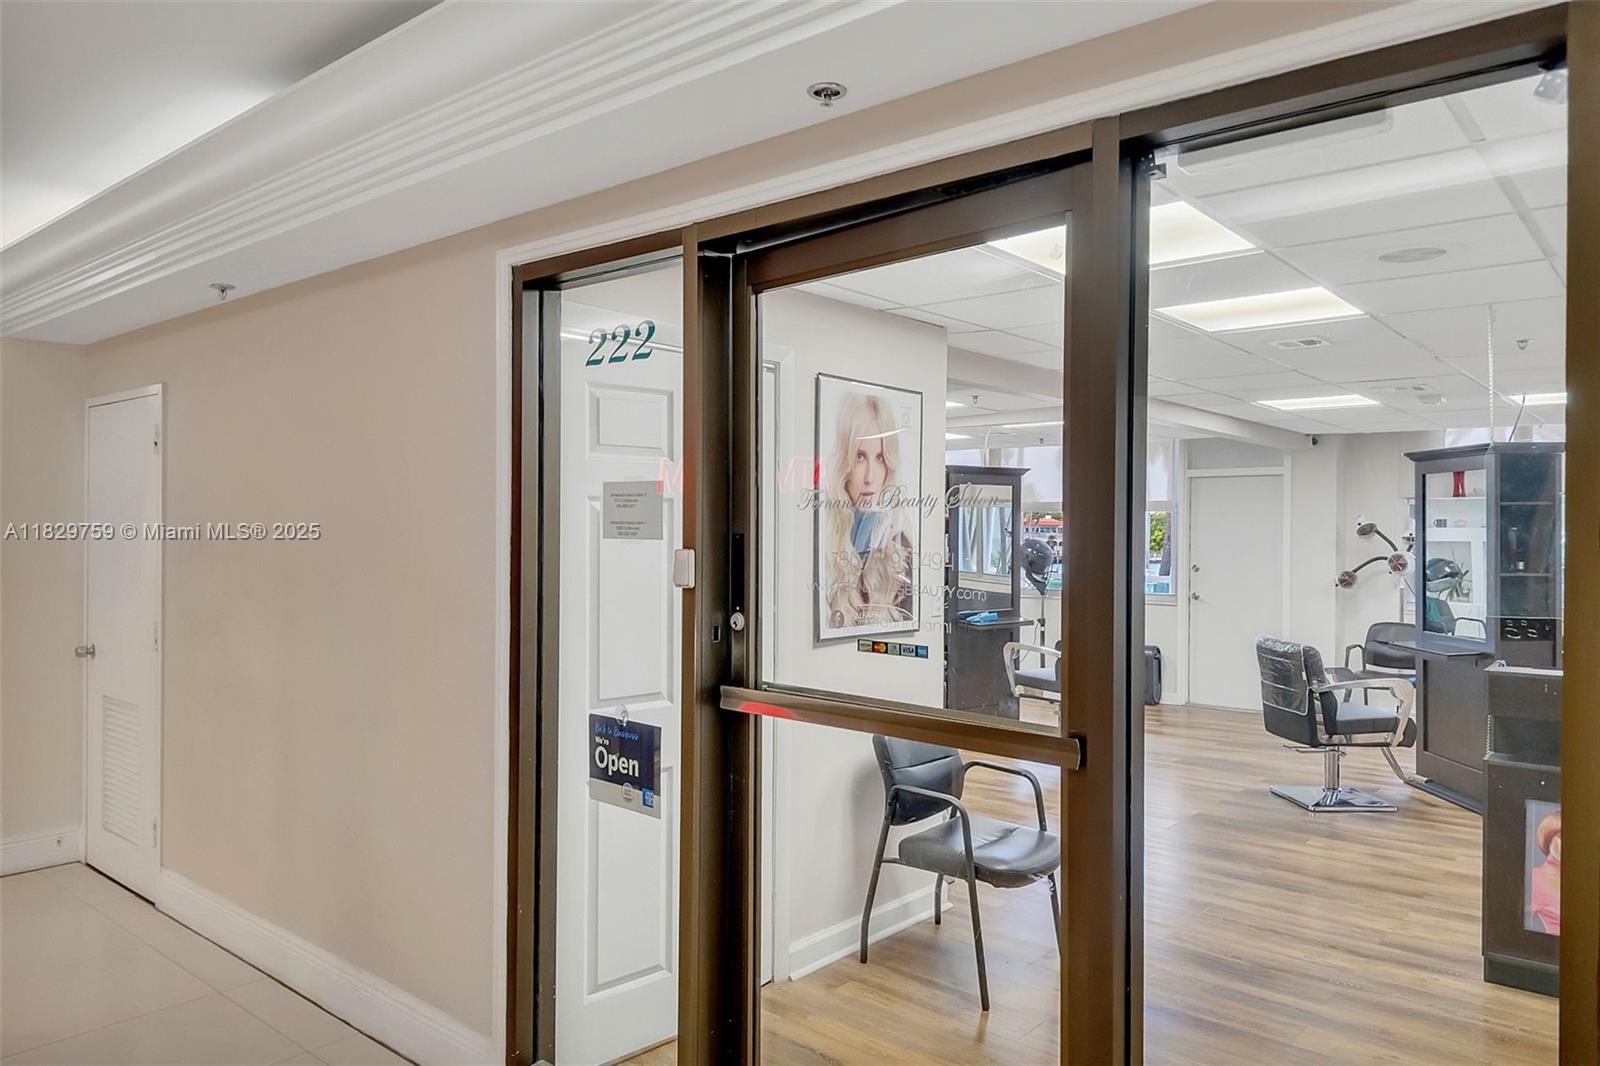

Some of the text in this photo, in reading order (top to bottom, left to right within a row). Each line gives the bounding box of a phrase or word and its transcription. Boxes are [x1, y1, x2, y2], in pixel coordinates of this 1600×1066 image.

[585, 319, 656, 367] 222
[877, 484, 939, 518] Beauty
[945, 481, 1001, 509] Salon
[902, 646, 915, 654] VISA
[594, 745, 640, 778] Open
